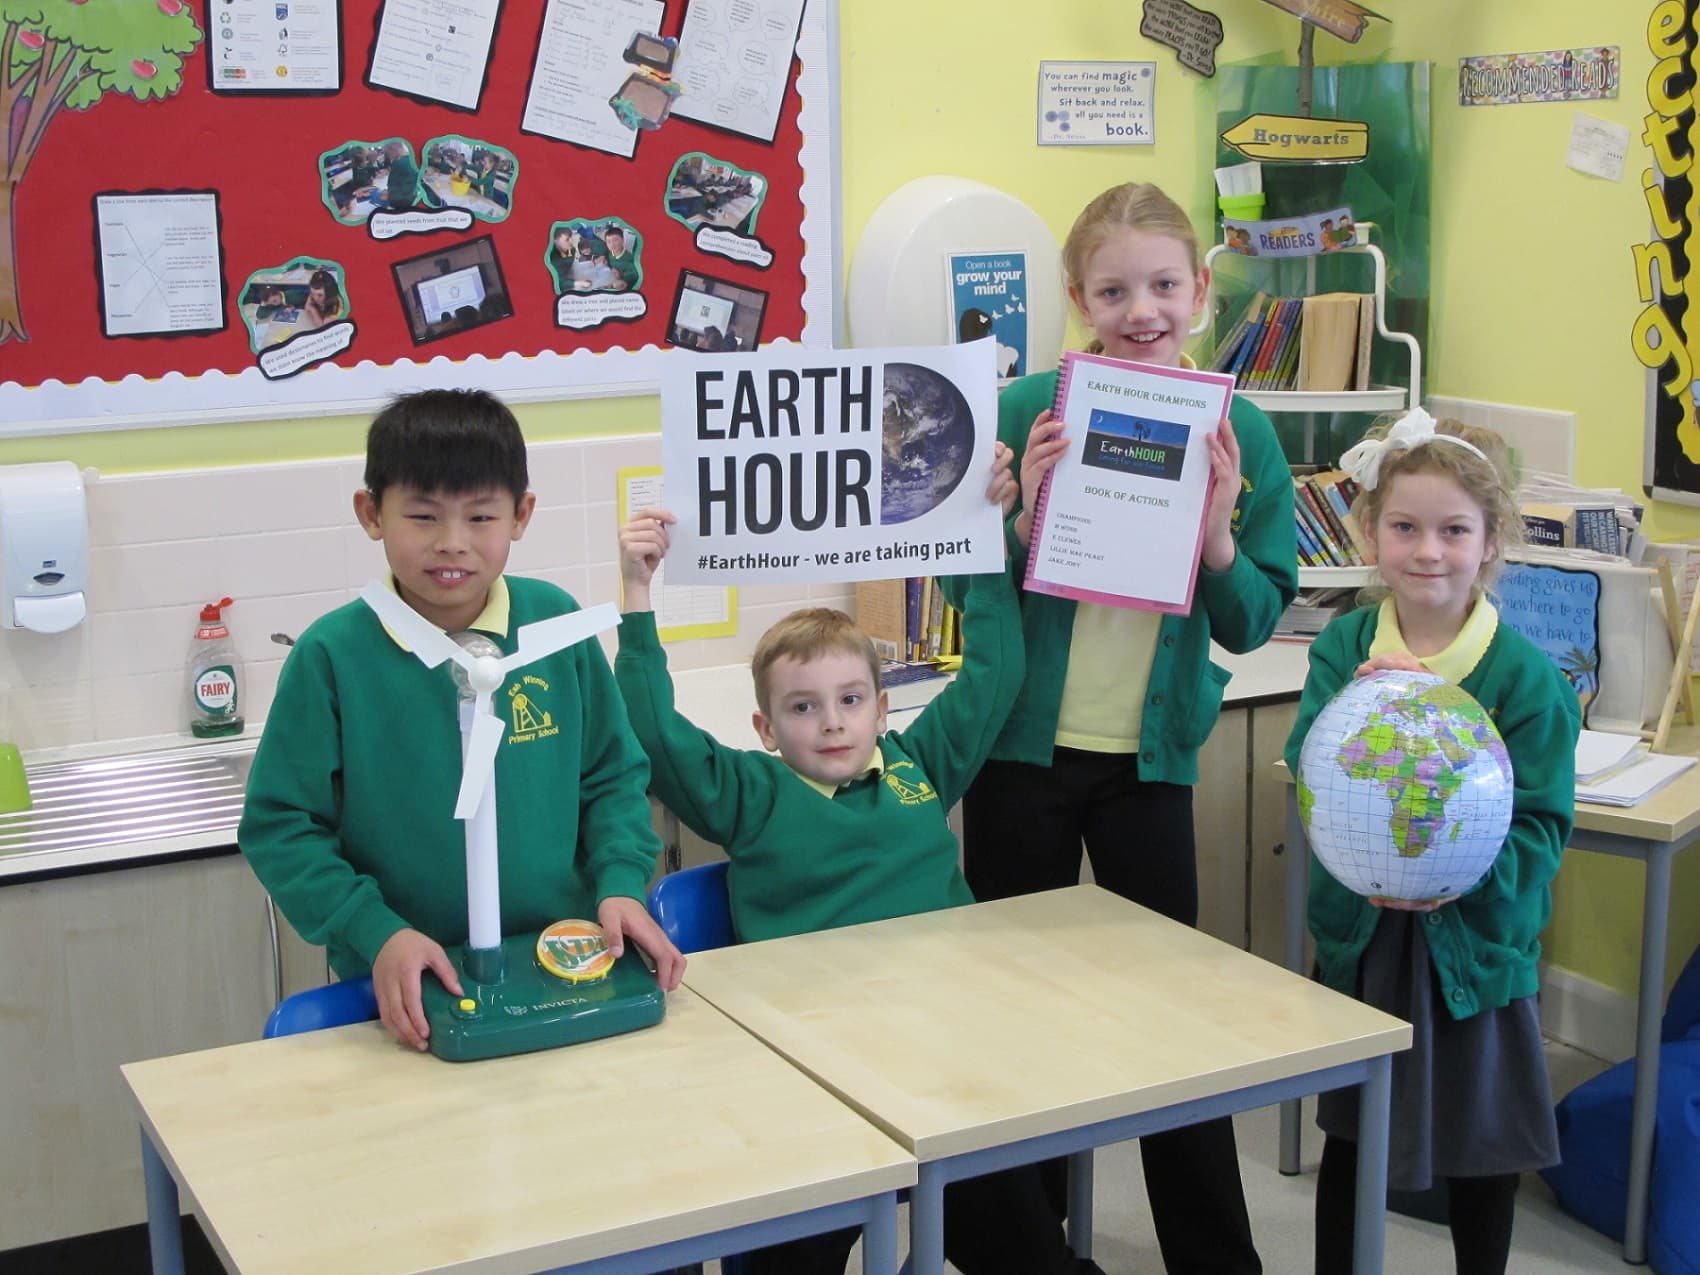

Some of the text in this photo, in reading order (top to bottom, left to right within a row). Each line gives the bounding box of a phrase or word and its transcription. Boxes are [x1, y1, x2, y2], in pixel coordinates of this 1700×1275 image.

[1044, 72, 1060, 80] You
[1082, 72, 1099, 80] find
[1102, 71, 1137, 85] magic
[1462, 59, 1615, 98] RECOMMENDED READS
[1050, 84, 1091, 92] wherever
[1094, 86, 1111, 94] you
[1060, 98, 1072, 106] Sit
[1075, 98, 1097, 106] back
[1100, 98, 1117, 106] and
[1075, 110, 1086, 118] all
[1088, 112, 1104, 120] you
[1106, 110, 1126, 118] need
[1106, 122, 1148, 136] book.
[1253, 128, 1349, 148] Hogwarts
[1260, 232, 1316, 250] READERS
[965, 260, 986, 270] Open
[994, 260, 1011, 268] book
[956, 270, 1022, 286] grow your
[974, 282, 1006, 296] mind
[696, 366, 872, 440] EARTH
[1087, 380, 1207, 409] EARTH HOUR CHAMPIONS
[698, 448, 872, 537] HOUR
[1084, 485, 1170, 508] BOOK OF ACTIONS
[1526, 524, 1560, 542] ollins
[698, 553, 800, 570] #EarthHour
[814, 552, 840, 566] we
[844, 549, 872, 564] are
[876, 542, 930, 562] taking
[934, 537, 972, 557] part
[1502, 572, 1594, 597] eading gives us
[1560, 600, 1572, 616] to
[1573, 606, 1592, 625] go
[1525, 624, 1542, 638] we
[1546, 622, 1576, 642] have
[1580, 630, 1592, 643] to
[200, 682, 230, 697] FAIRY
[508, 725, 560, 744] Primary School
[532, 996, 588, 1012] INVICTA
